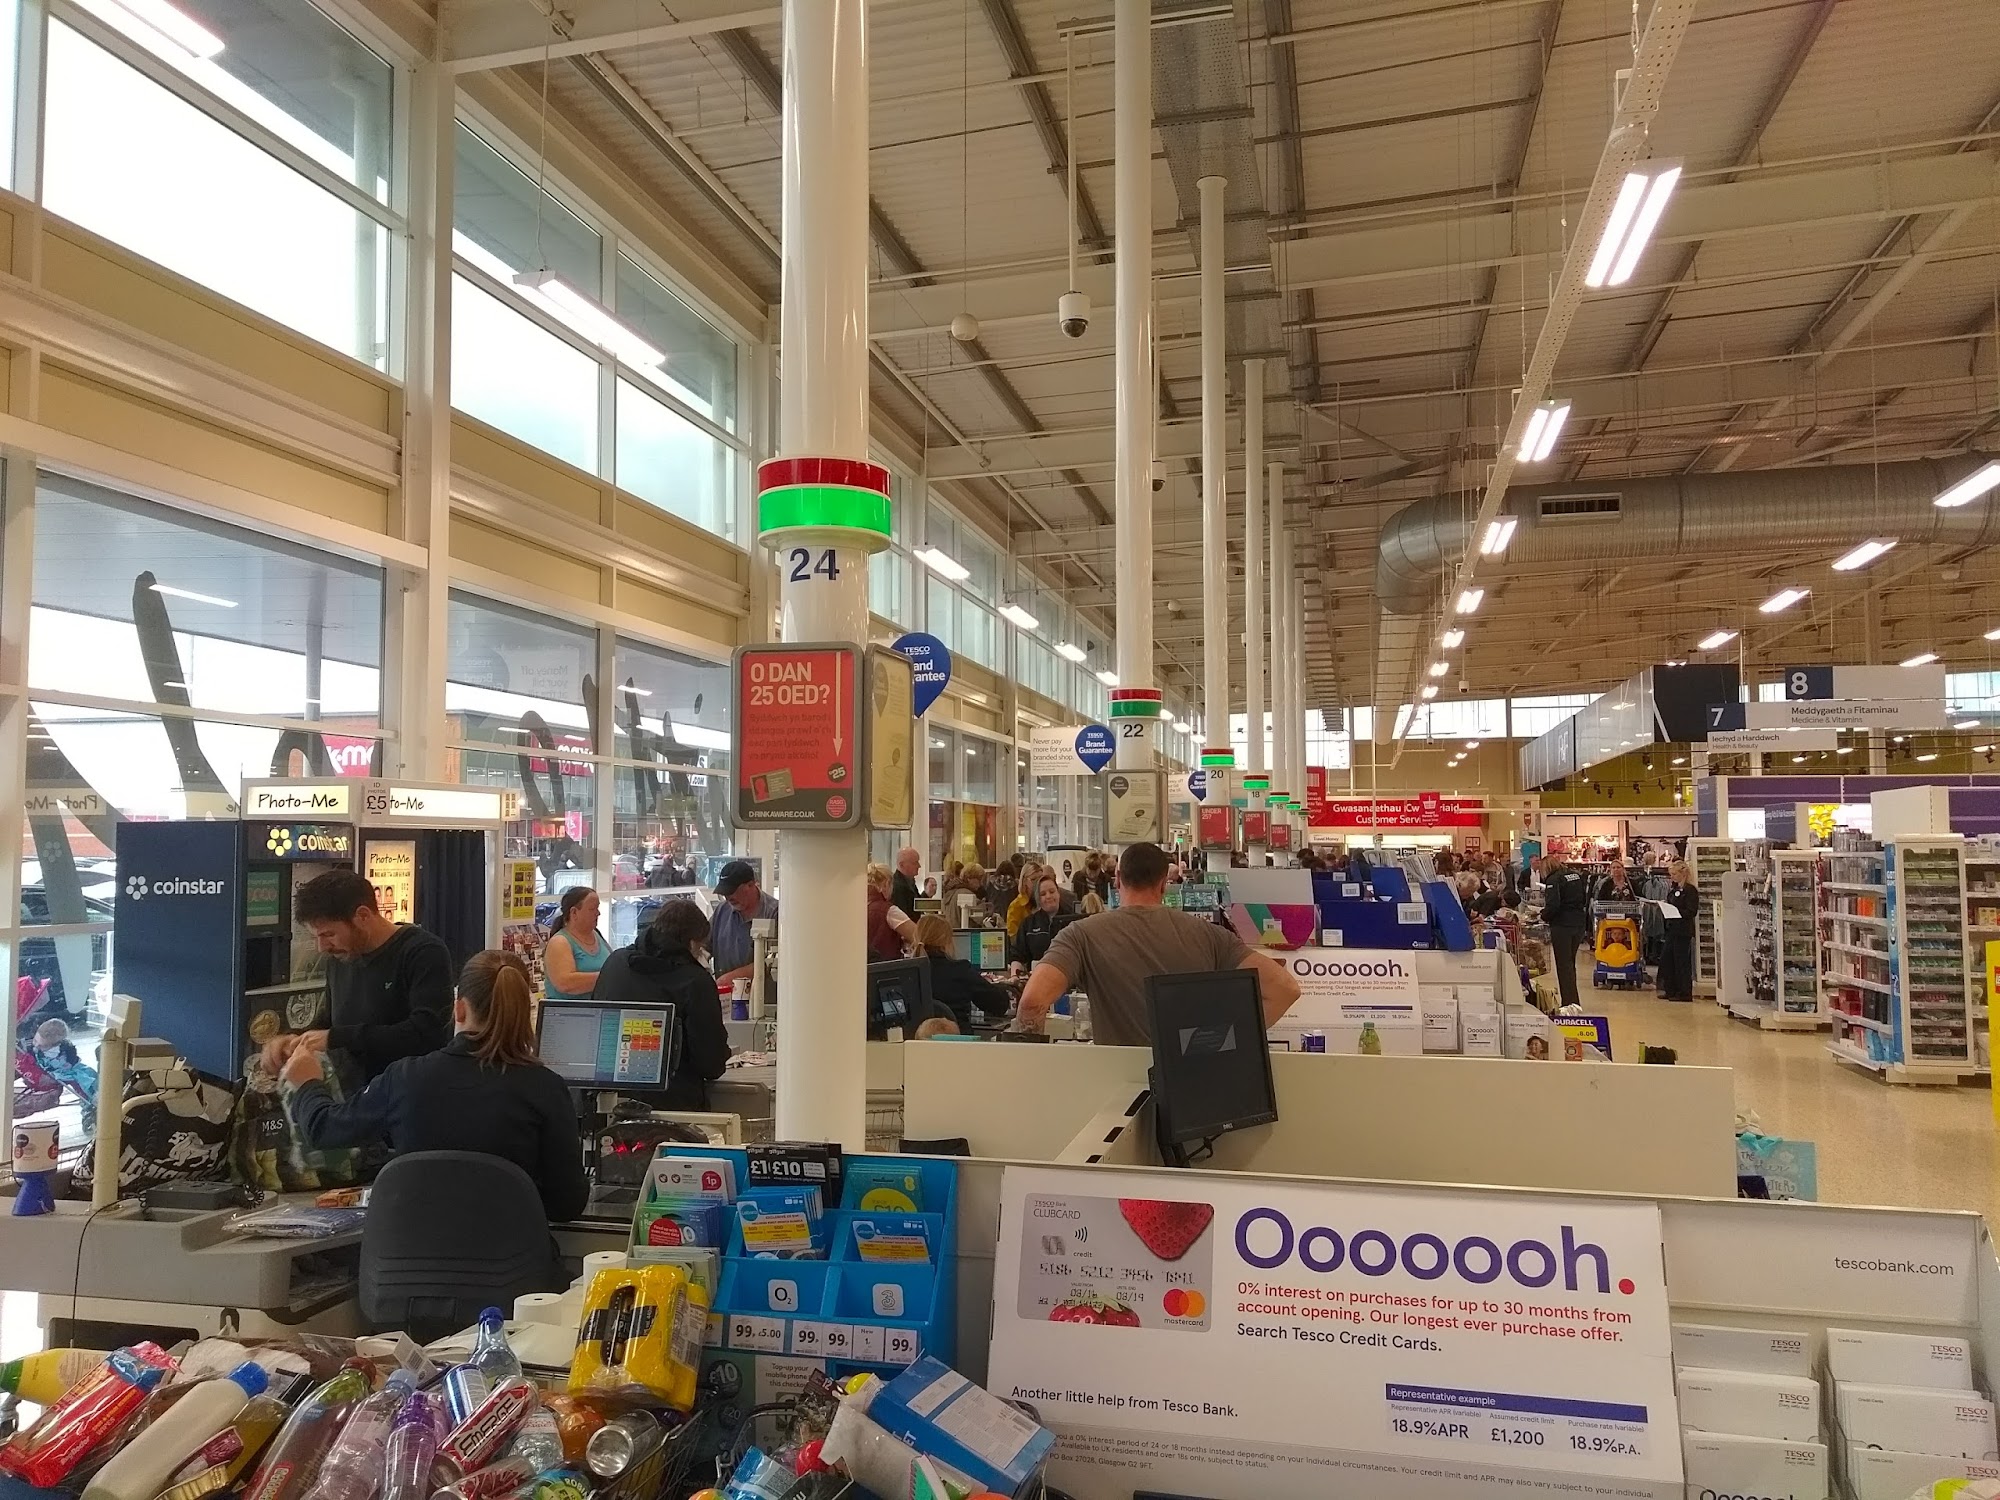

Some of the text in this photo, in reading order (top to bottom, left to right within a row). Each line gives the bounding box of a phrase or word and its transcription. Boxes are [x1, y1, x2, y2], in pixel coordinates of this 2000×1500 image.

[789, 549, 840, 583] 24
[914, 659, 933, 671] and
[751, 662, 812, 683] O DAN
[914, 672, 945, 681] antee
[1790, 671, 1809, 695] 8
[750, 684, 831, 706] 25 OED?
[1710, 707, 1725, 727] 7
[1791, 706, 1846, 716] Meddygaeth
[1854, 706, 1899, 714] Fitaminau
[1123, 723, 1144, 737] 22
[1058, 754, 1074, 762] shop.
[1211, 770, 1224, 779] 20
[258, 793, 339, 809] Photo-Me
[366, 795, 387, 810] £5
[390, 795, 425, 810] to-Me
[1333, 803, 1460, 813] Gwasanaethau Cwriaid
[748, 810, 815, 818] DRINKAWARE.CO.UK
[1355, 815, 1398, 824] Customer
[1400, 815, 1421, 824] Servi
[298, 833, 349, 852] coinstar
[370, 854, 411, 864] Photo-Me
[153, 877, 225, 895] coinstar
[1293, 958, 1409, 978] Ooooooh.
[1554, 1018, 1594, 1026] DURACELL
[262, 1118, 284, 1132] M&S
[772, 1161, 801, 1176] £10
[706, 1176, 717, 1187] 1p
[1033, 1208, 1081, 1220] CLUBCARD
[1234, 1207, 1636, 1295] Ooooooh.
[1080, 1265, 1113, 1279] 5212
[1120, 1268, 1154, 1282] 3456
[1834, 1257, 1954, 1276] tescobank.com
[1237, 1282, 1631, 1324] 0% interest on purchases for up to 30 months from
[1163, 1318, 1204, 1327] mastercard
[1237, 1301, 1623, 1342] account opening. Our longest ever purchase offer.
[758, 1328, 782, 1339] £5.00
[1237, 1323, 1442, 1351] Search Tesco Credit Cards.
[1770, 1339, 1801, 1347] TESCO
[1930, 1344, 1963, 1353] TESCO
[709, 1361, 738, 1384] £10
[772, 1362, 794, 1371] Top-up
[787, 1372, 808, 1380] phone
[1011, 1386, 1238, 1417] Another little help from Tesco Bank.
[1391, 1388, 1496, 1406] Representative example
[1778, 1393, 1810, 1403] TESCO
[1391, 1404, 1482, 1418] Representative APR (variable)
[1955, 1406, 1988, 1416] TESCO
[1489, 1412, 1555, 1425] Assumed credit limit
[1392, 1418, 1470, 1439] 18.9%APR
[1568, 1419, 1598, 1429] Purchase
[1614, 1424, 1645, 1434] (variable)
[1491, 1428, 1544, 1446] £1,200
[1569, 1435, 1641, 1456] 18.9%P.A.
[1075, 1434, 1087, 1442] 0%
[1088, 1436, 1115, 1445] interest
[1116, 1438, 1140, 1448] period
[1141, 1440, 1149, 1448] of
[1151, 1441, 1160, 1449] 24
[1180, 1444, 1207, 1454] months
[1208, 1447, 1235, 1456] instead
[1236, 1451, 1275, 1462] depending
[1287, 1456, 1304, 1464] your
[1306, 1456, 1341, 1467] individual
[1342, 1461, 1399, 1473] circumstances.
[1784, 1450, 1815, 1459] TESCO
[1966, 1466, 1999, 1476] TESCO
